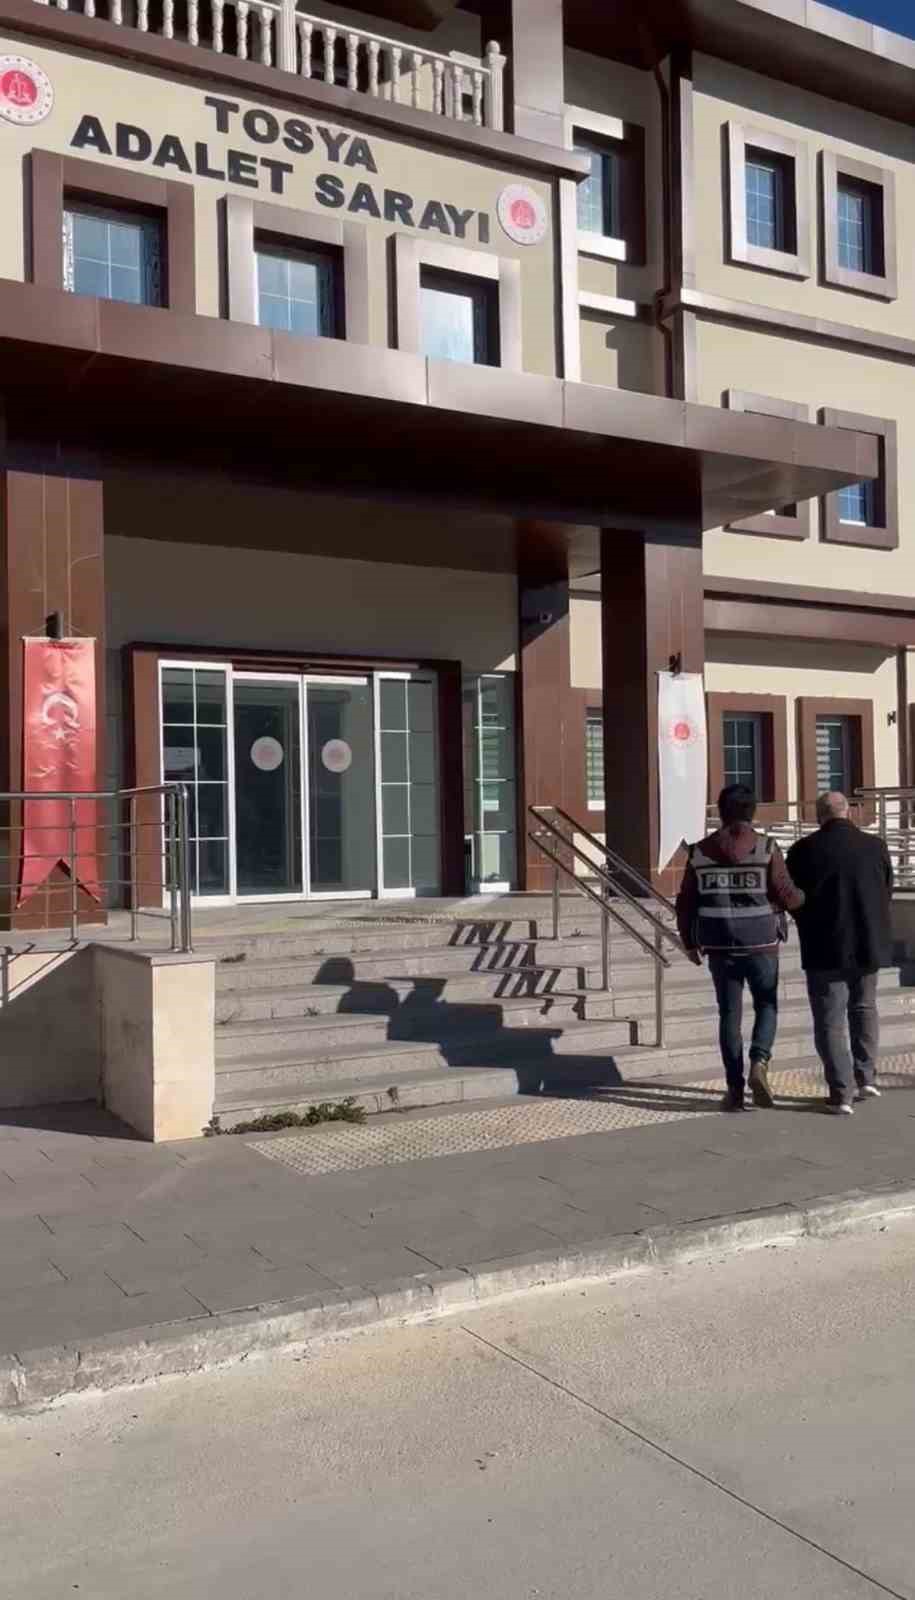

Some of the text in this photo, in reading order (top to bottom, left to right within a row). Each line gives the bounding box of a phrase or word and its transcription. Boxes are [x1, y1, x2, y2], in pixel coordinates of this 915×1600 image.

[70, 115, 489, 243] ADALET SARAYI
[205, 96, 378, 173] TOSYA
